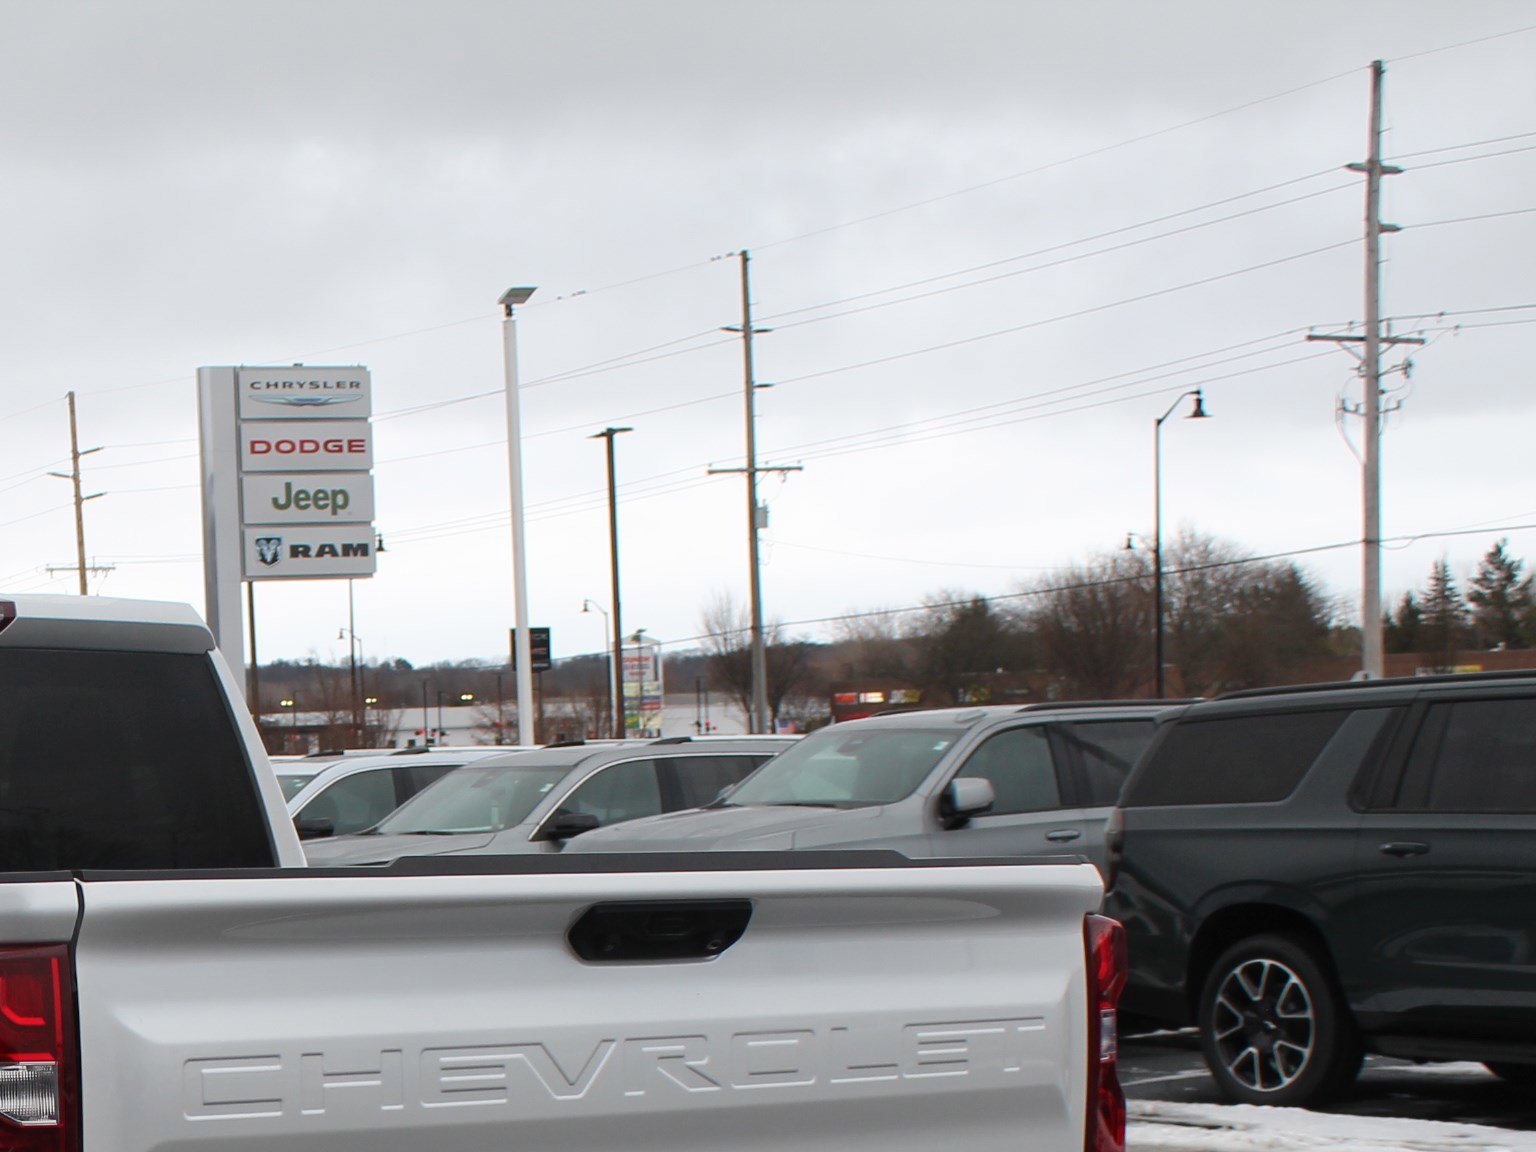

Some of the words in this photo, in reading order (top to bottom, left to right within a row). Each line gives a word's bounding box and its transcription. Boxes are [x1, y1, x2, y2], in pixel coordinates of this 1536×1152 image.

[250, 380, 362, 390] CHRYSLER
[249, 439, 367, 454] DODGE
[271, 482, 350, 515] Jeep
[289, 543, 369, 558] RAM
[183, 1016, 1046, 1120] CHEVROLET
